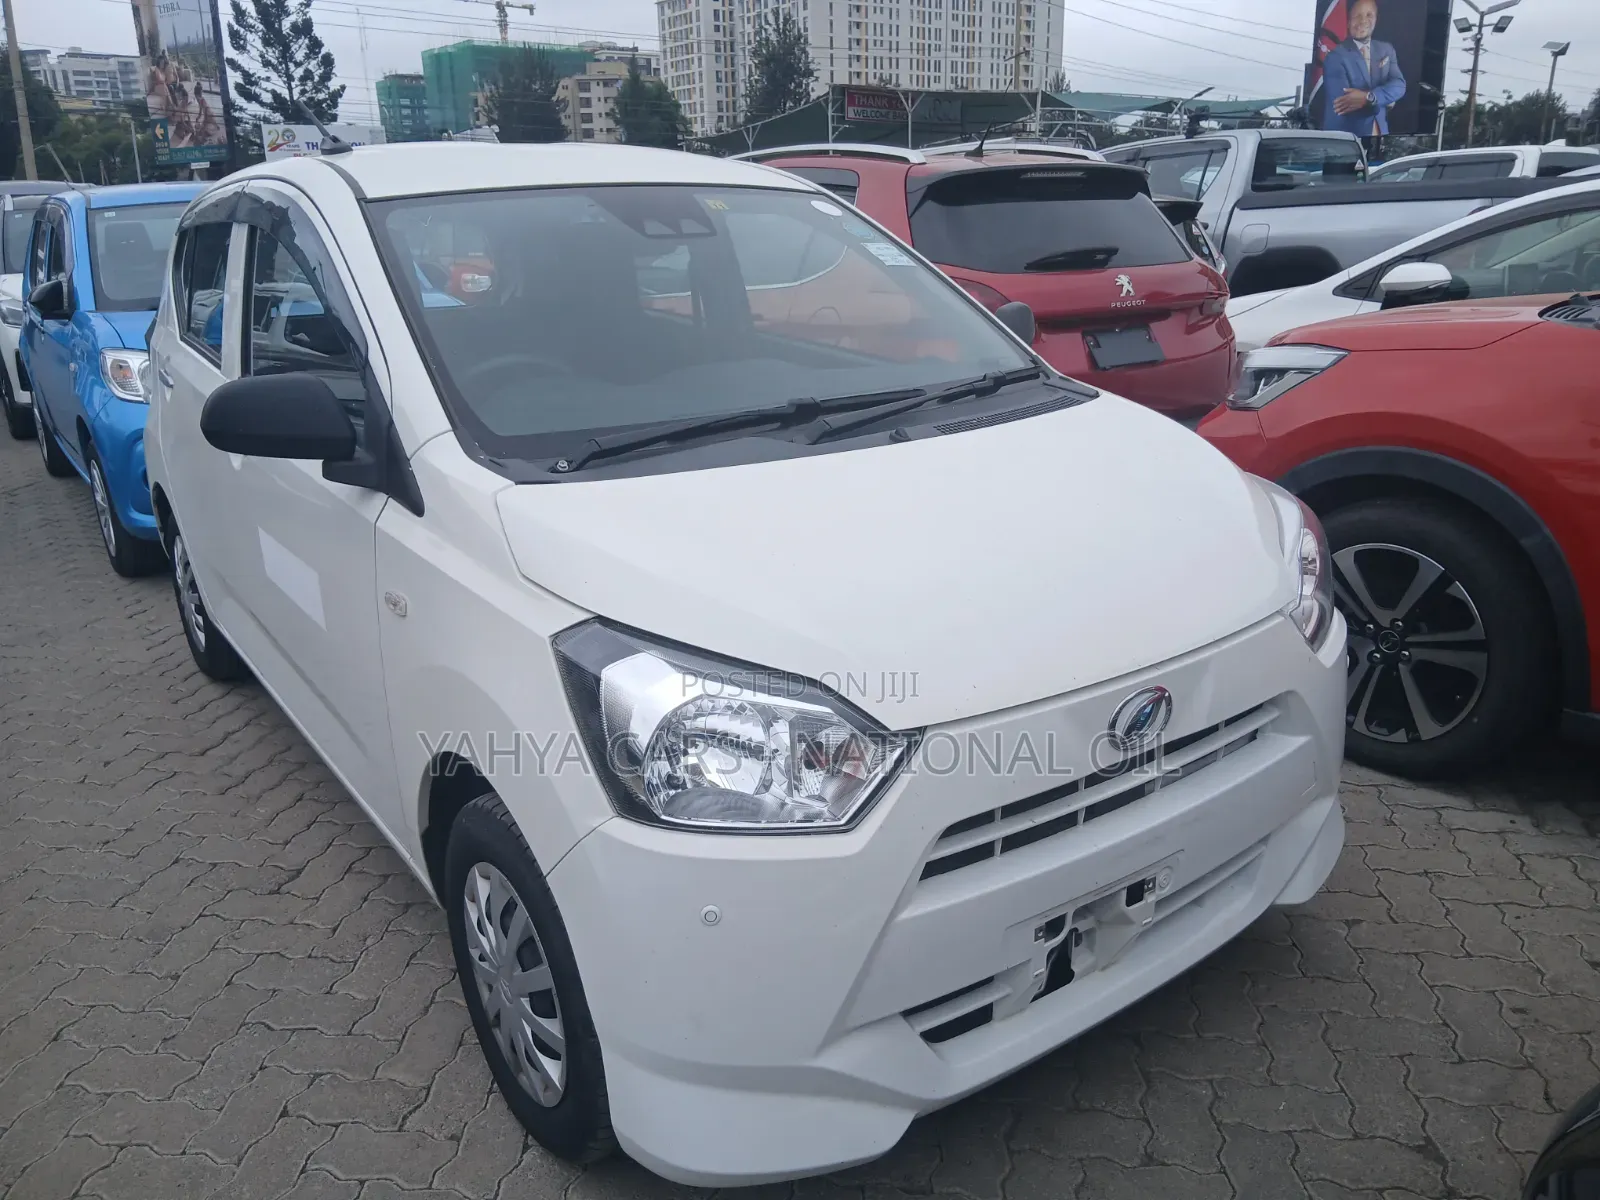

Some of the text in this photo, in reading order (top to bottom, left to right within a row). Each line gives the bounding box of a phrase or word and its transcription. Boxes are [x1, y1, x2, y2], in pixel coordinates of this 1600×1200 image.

[853, 95, 889, 108] THANK
[853, 108, 891, 119] WELCOME
[1110, 299, 1146, 308] PEUGEOT
